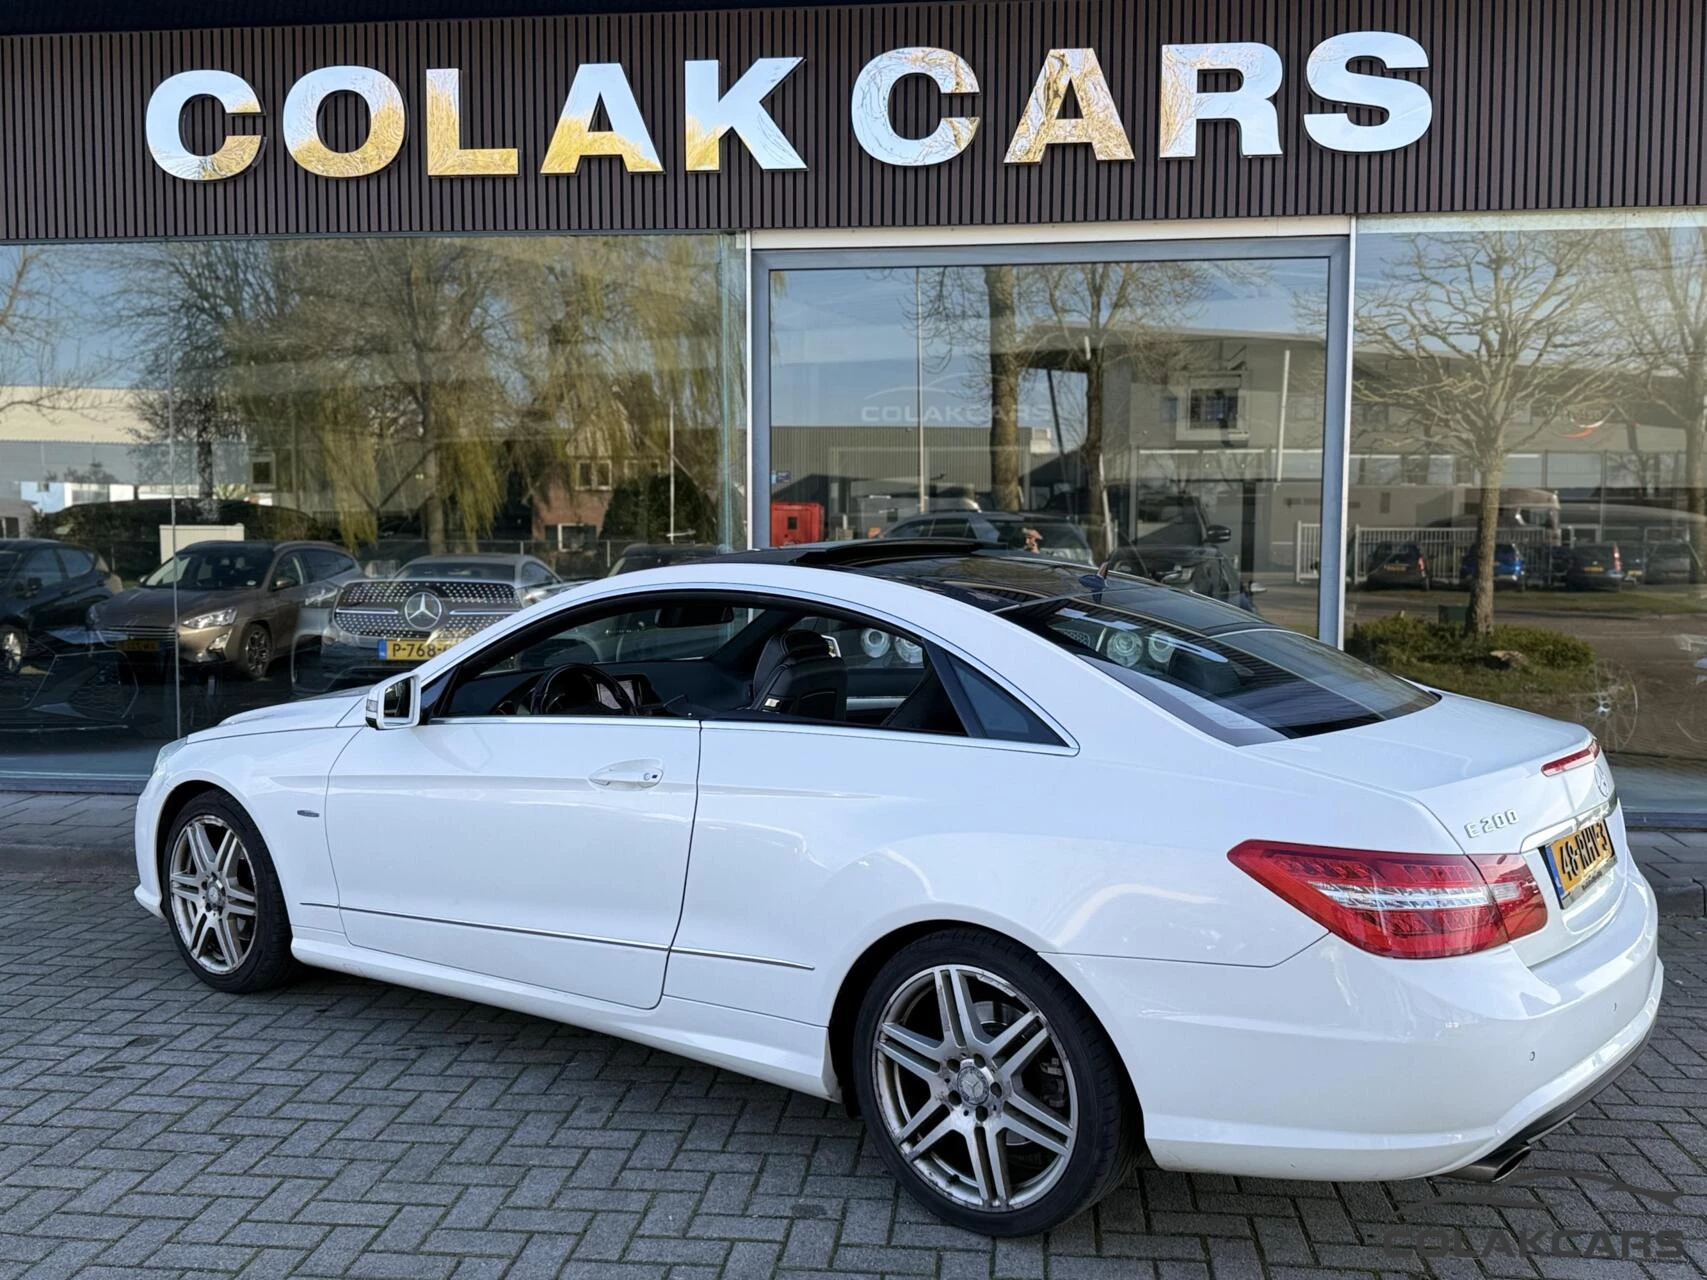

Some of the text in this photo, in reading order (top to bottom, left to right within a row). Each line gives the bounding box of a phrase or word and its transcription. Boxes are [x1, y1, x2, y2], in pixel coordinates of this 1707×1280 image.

[145, 31, 1434, 183] COLAK CARS
[392, 643, 448, 658] P-768-
[1464, 809, 1520, 839] E 200
